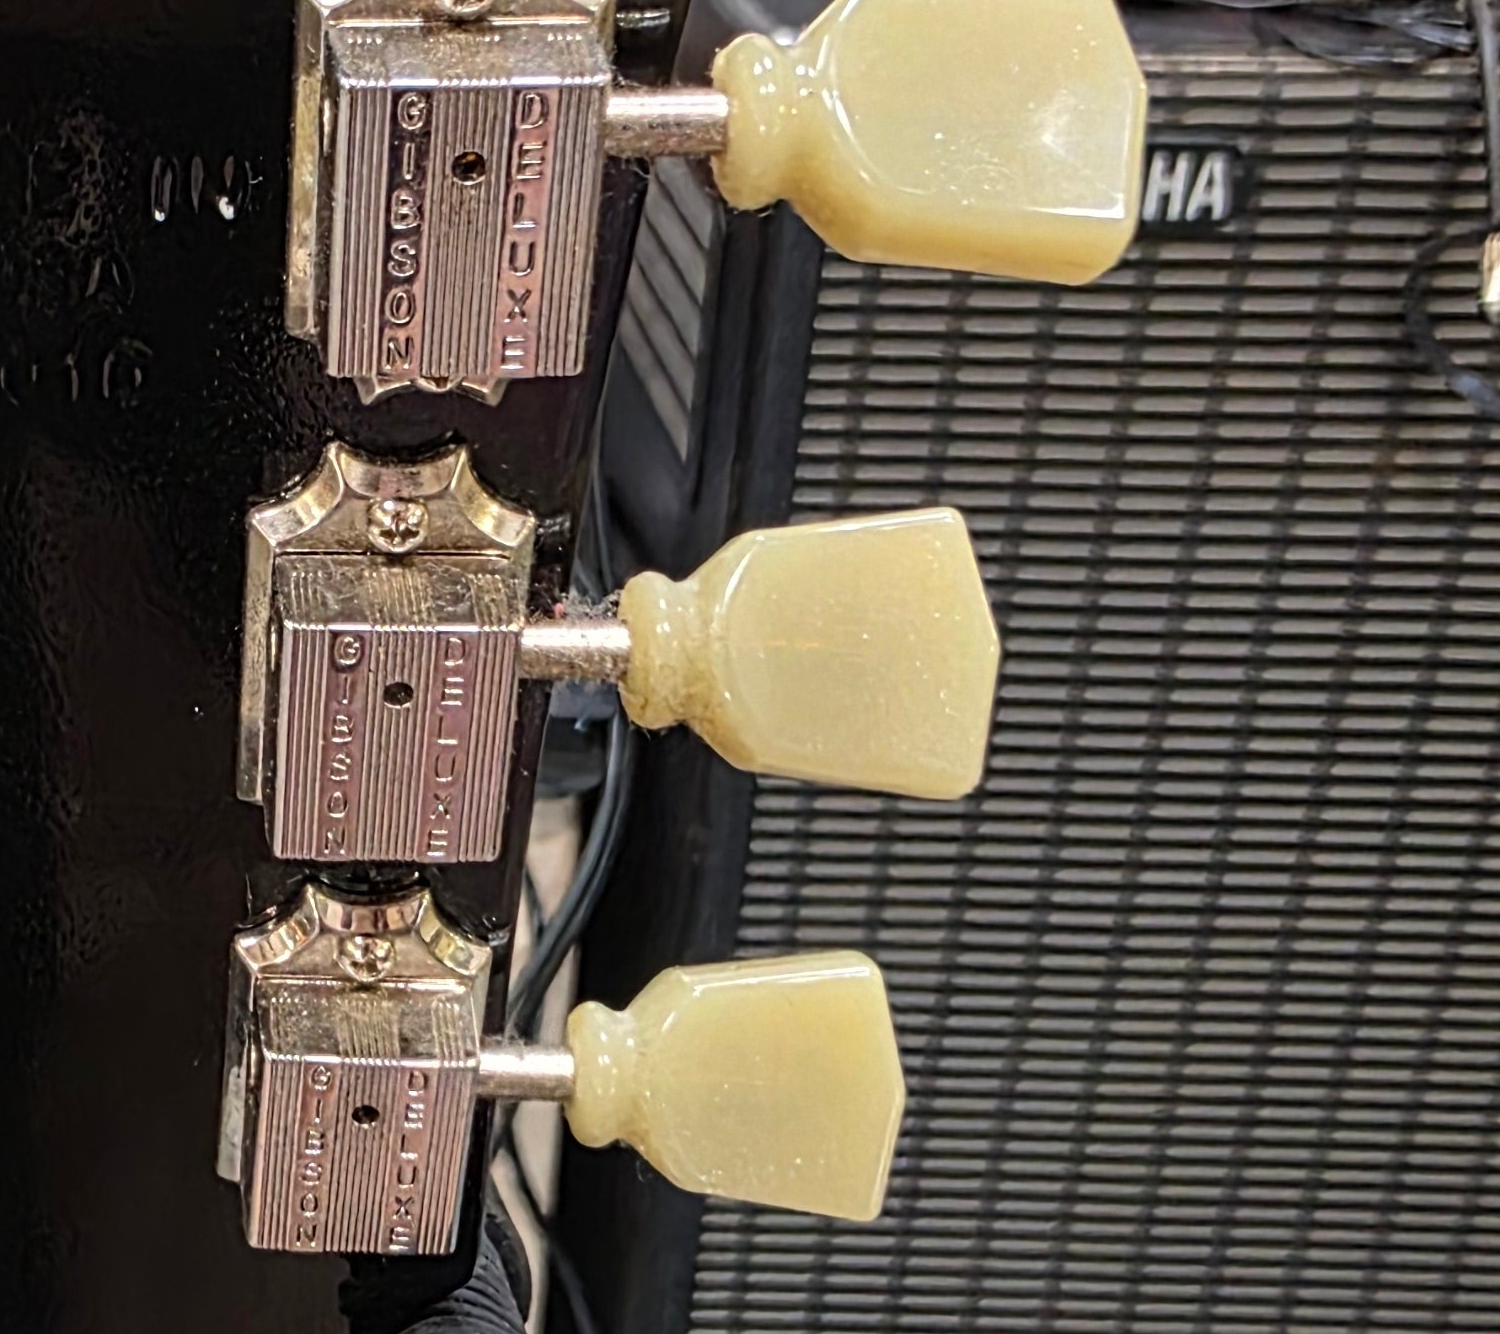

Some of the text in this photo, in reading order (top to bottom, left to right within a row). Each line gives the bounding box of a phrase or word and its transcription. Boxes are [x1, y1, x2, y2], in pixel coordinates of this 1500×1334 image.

[384, 91, 427, 370] GIBSON
[500, 91, 549, 370] DELUXE
[324, 636, 362, 854] GIBSON
[426, 637, 467, 855] DELUXE
[295, 1065, 332, 1247] GIBSON
[389, 1069, 427, 1250] DELUXE
